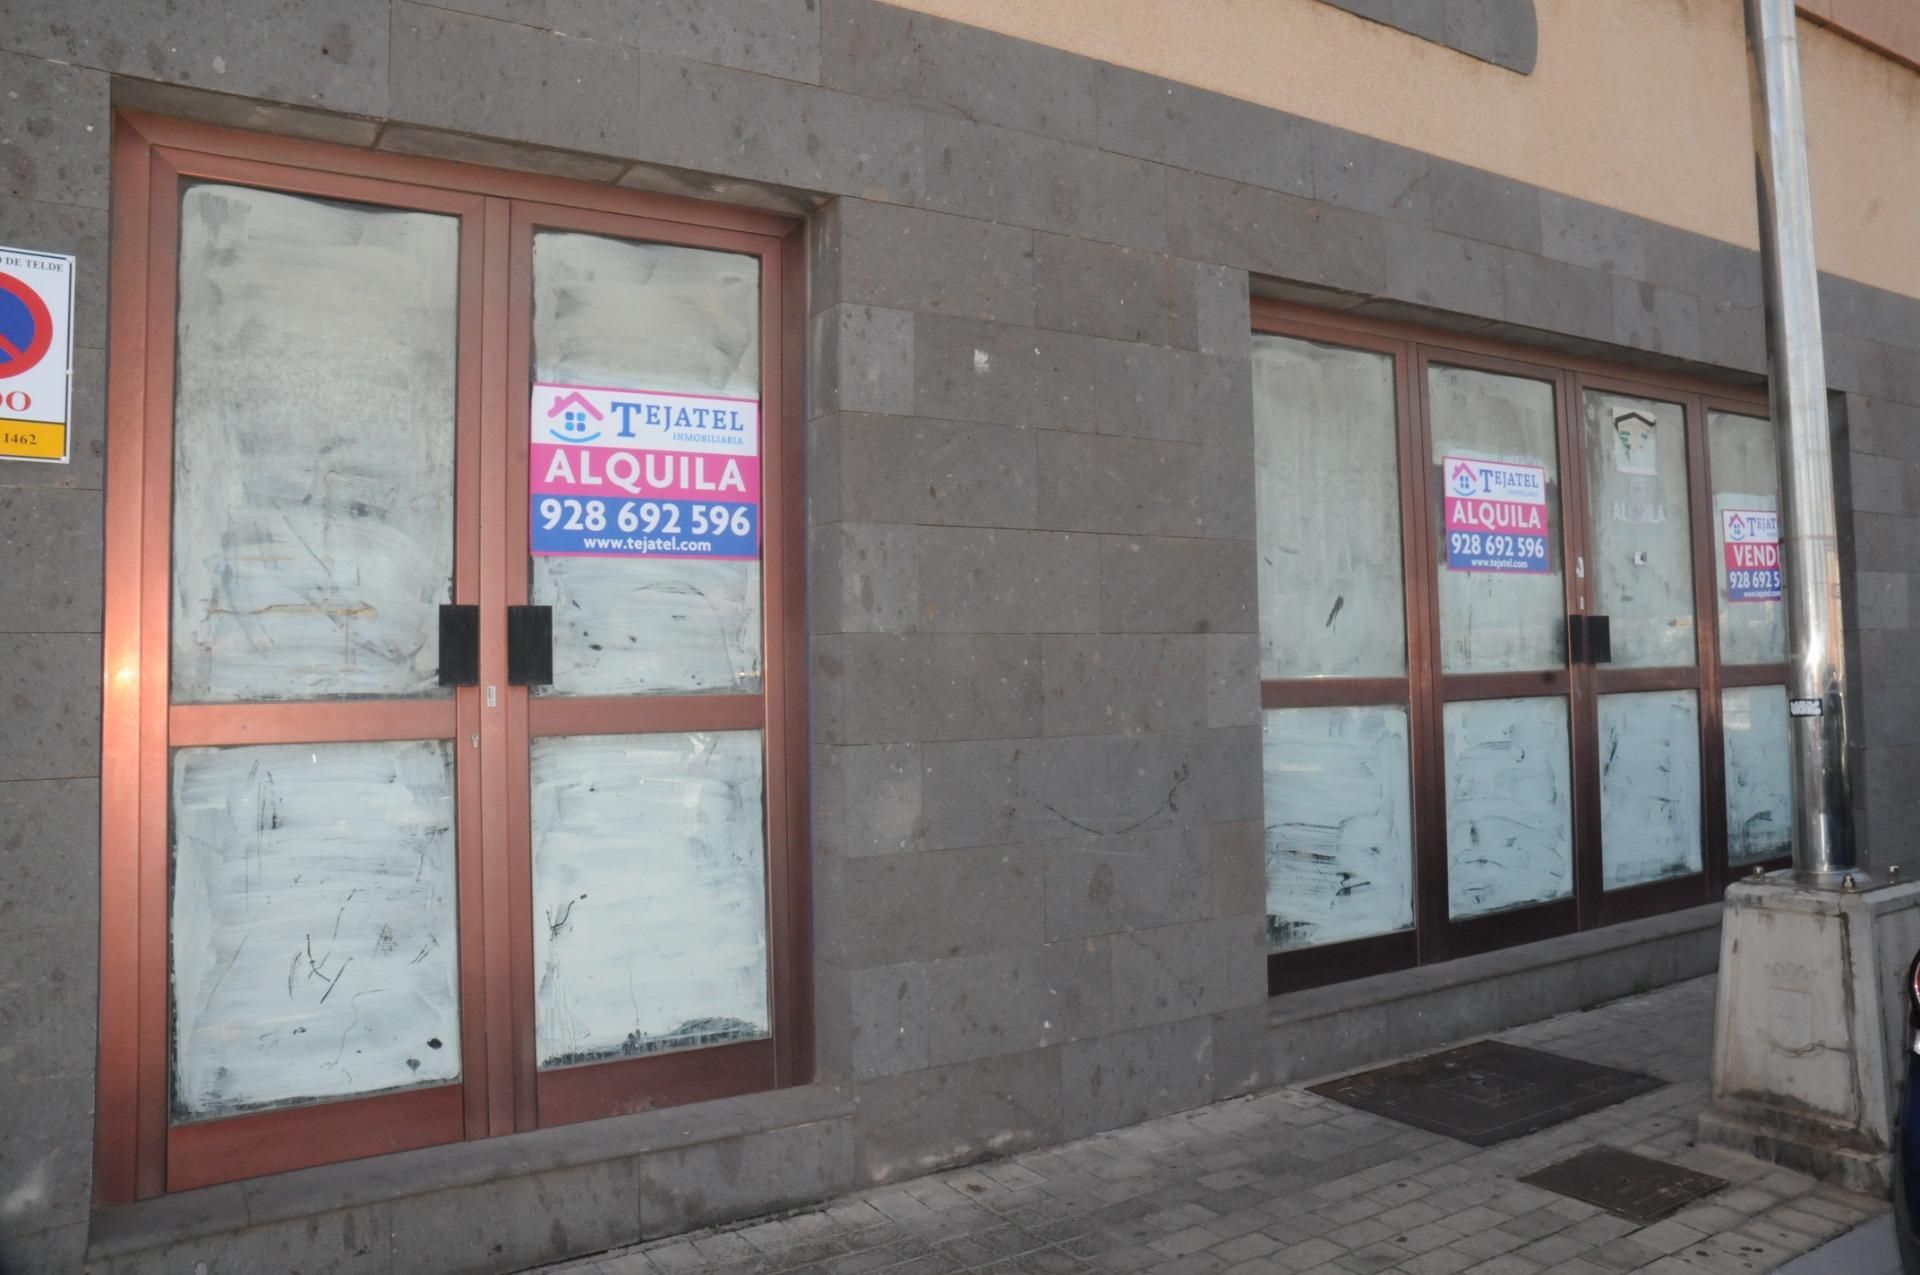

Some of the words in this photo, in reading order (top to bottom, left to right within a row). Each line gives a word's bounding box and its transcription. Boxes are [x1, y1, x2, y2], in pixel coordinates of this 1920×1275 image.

[6, 256, 22, 266] DE
[25, 259, 64, 272] TELDE
[0, 391, 32, 411] O
[611, 401, 744, 438] TEJATEL
[4, 432, 37, 445] 1462
[673, 432, 744, 445] INMOBILIARIA
[544, 448, 746, 494] ALQUILA
[1479, 468, 1539, 493] TEJATEL
[540, 498, 607, 532] 928
[617, 501, 681, 534] 692
[691, 504, 751, 537] 596
[1452, 500, 1542, 531] ALQUILA
[1746, 517, 1776, 536] TEJAT
[583, 535, 712, 553] www.tejatel.com
[1451, 532, 1481, 556] 928
[1485, 535, 1514, 557] 692
[1517, 537, 1545, 558] 596
[1733, 544, 1780, 568] VEND
[1729, 571, 1750, 589] 928
[1752, 571, 1772, 588] 692
